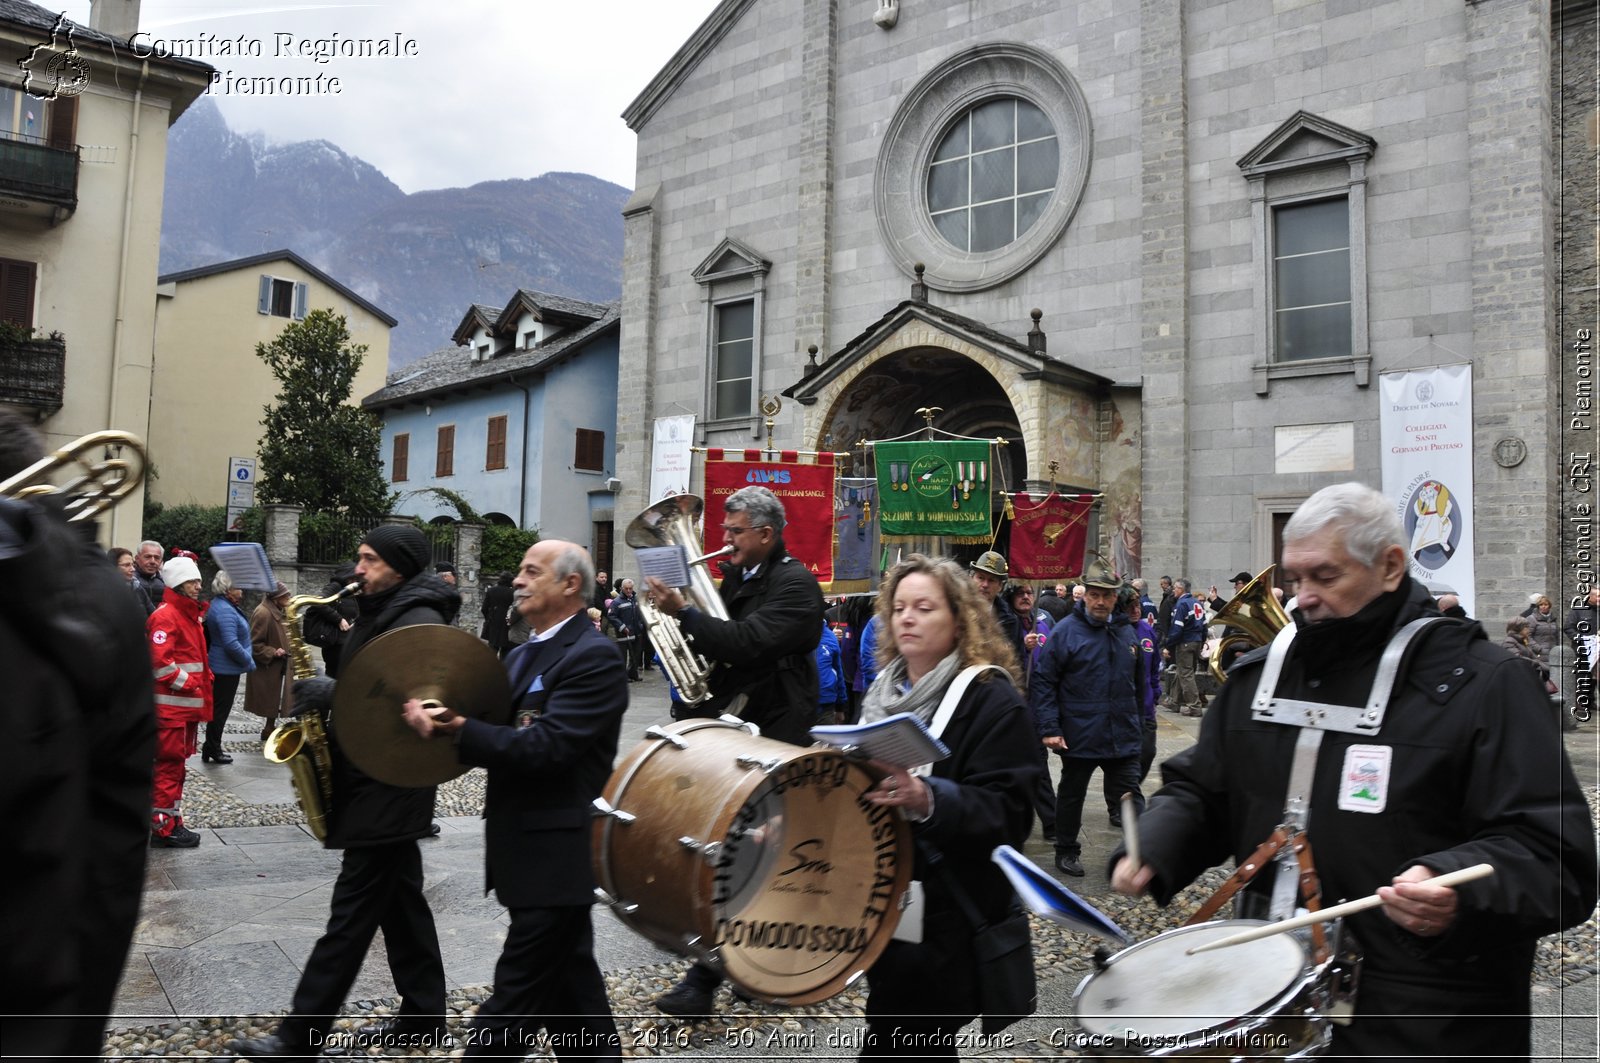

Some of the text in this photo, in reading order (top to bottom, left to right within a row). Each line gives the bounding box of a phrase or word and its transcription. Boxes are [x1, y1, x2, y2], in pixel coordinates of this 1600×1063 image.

[746, 469, 792, 484] AVIS
[882, 511, 913, 522] SEZIONE
[927, 511, 985, 522] DOMODOSSOLA
[714, 917, 869, 954] DOMODOSSOLA
